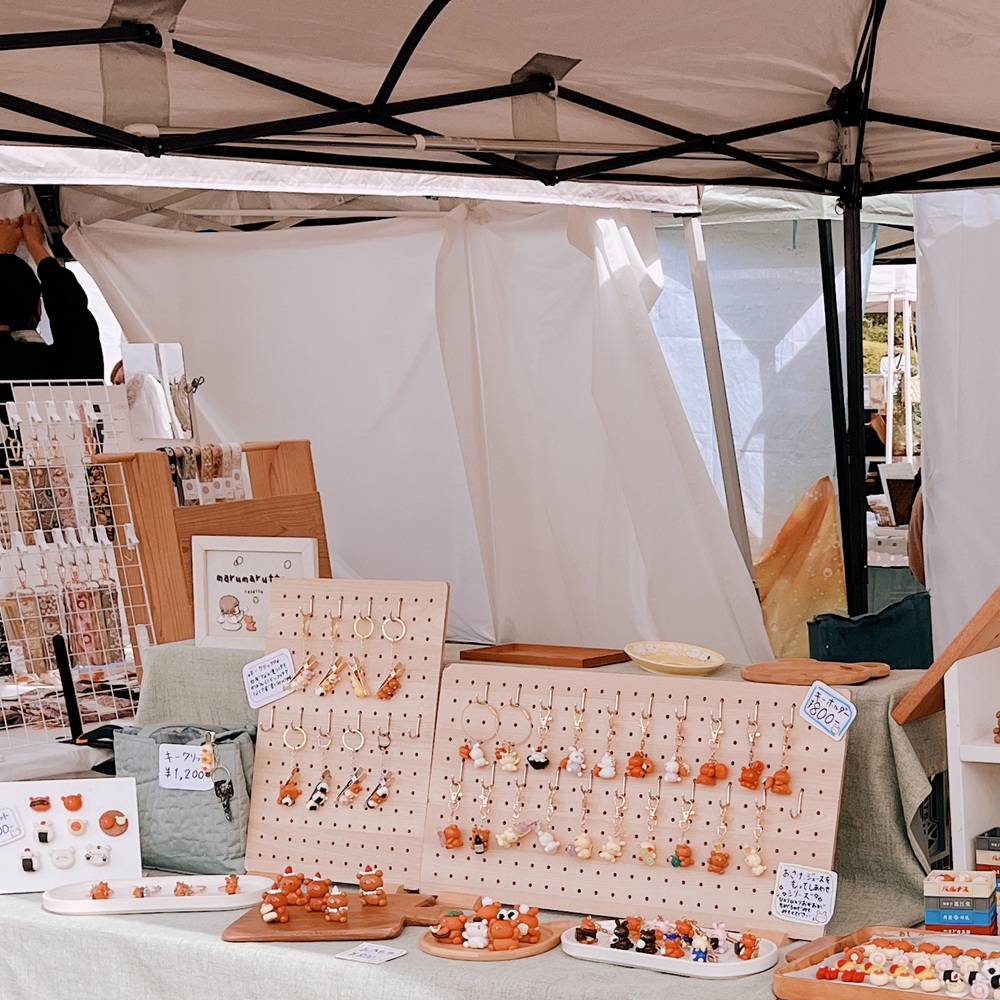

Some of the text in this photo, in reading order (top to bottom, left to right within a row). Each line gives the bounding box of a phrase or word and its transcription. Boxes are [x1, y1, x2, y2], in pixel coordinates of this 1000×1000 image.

[216, 573, 285, 584] marumarut
[165, 751, 203, 763] キークリッ
